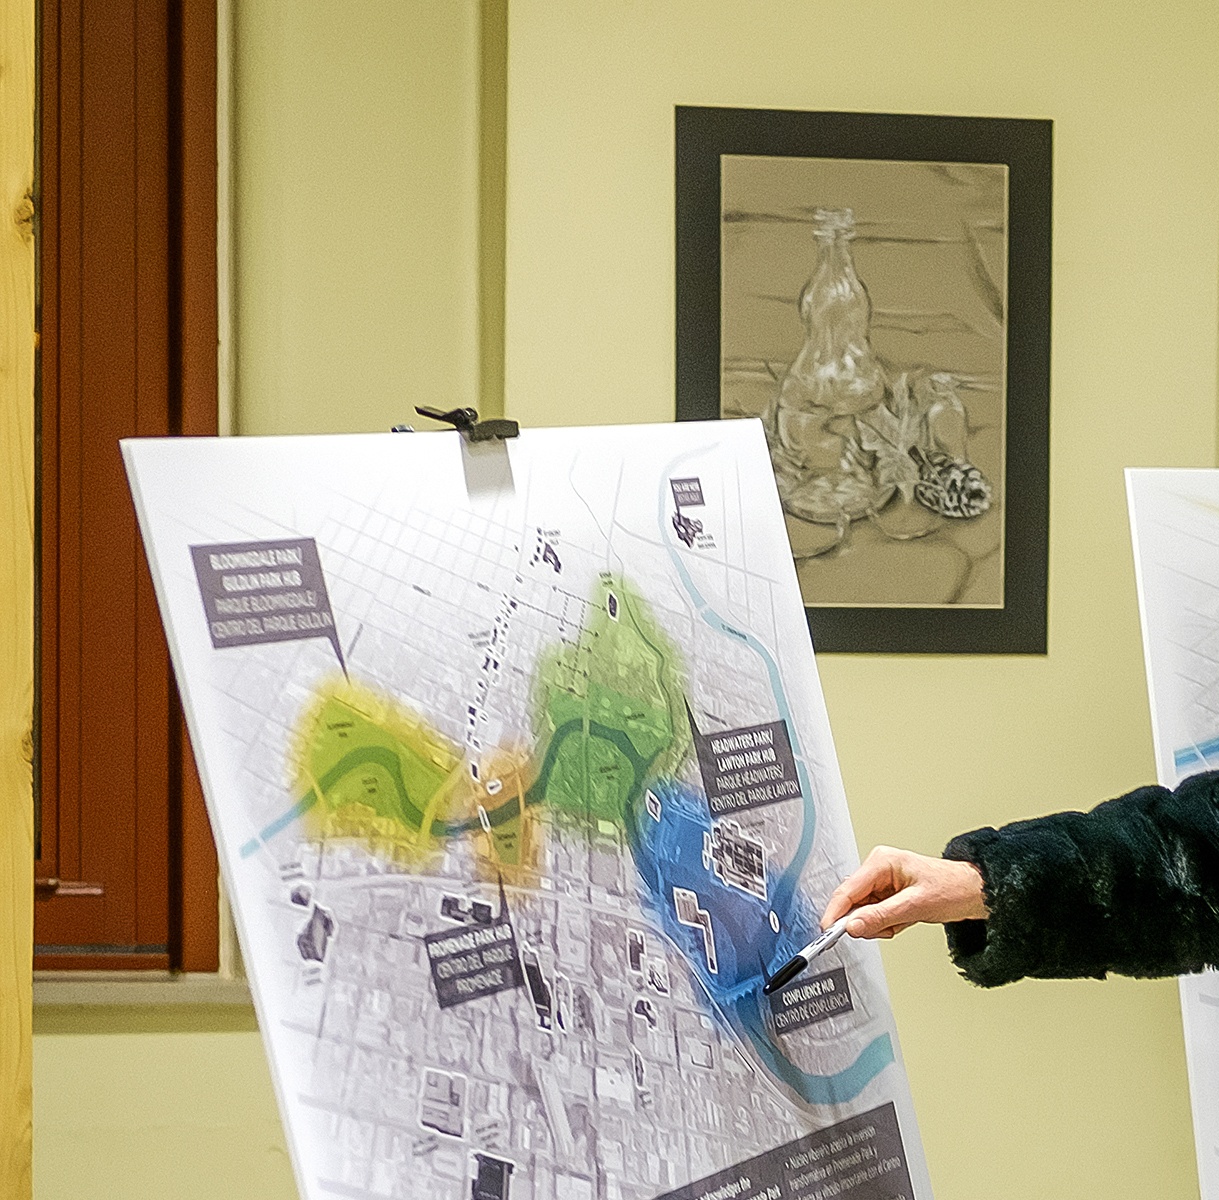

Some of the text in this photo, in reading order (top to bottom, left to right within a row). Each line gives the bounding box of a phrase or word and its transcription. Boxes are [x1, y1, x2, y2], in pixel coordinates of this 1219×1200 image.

[710, 728, 774, 755] HEADWATERS PARK/
[716, 747, 777, 773] LAWTON PARK HUB
[710, 779, 800, 812] CENTRO DEL PARQUE LAWTON
[715, 772, 743, 791] PARQUE
[782, 977, 835, 1007] CONFLUENCE HUB
[775, 991, 850, 1028] CENTRO DE CONFLUENCIA
